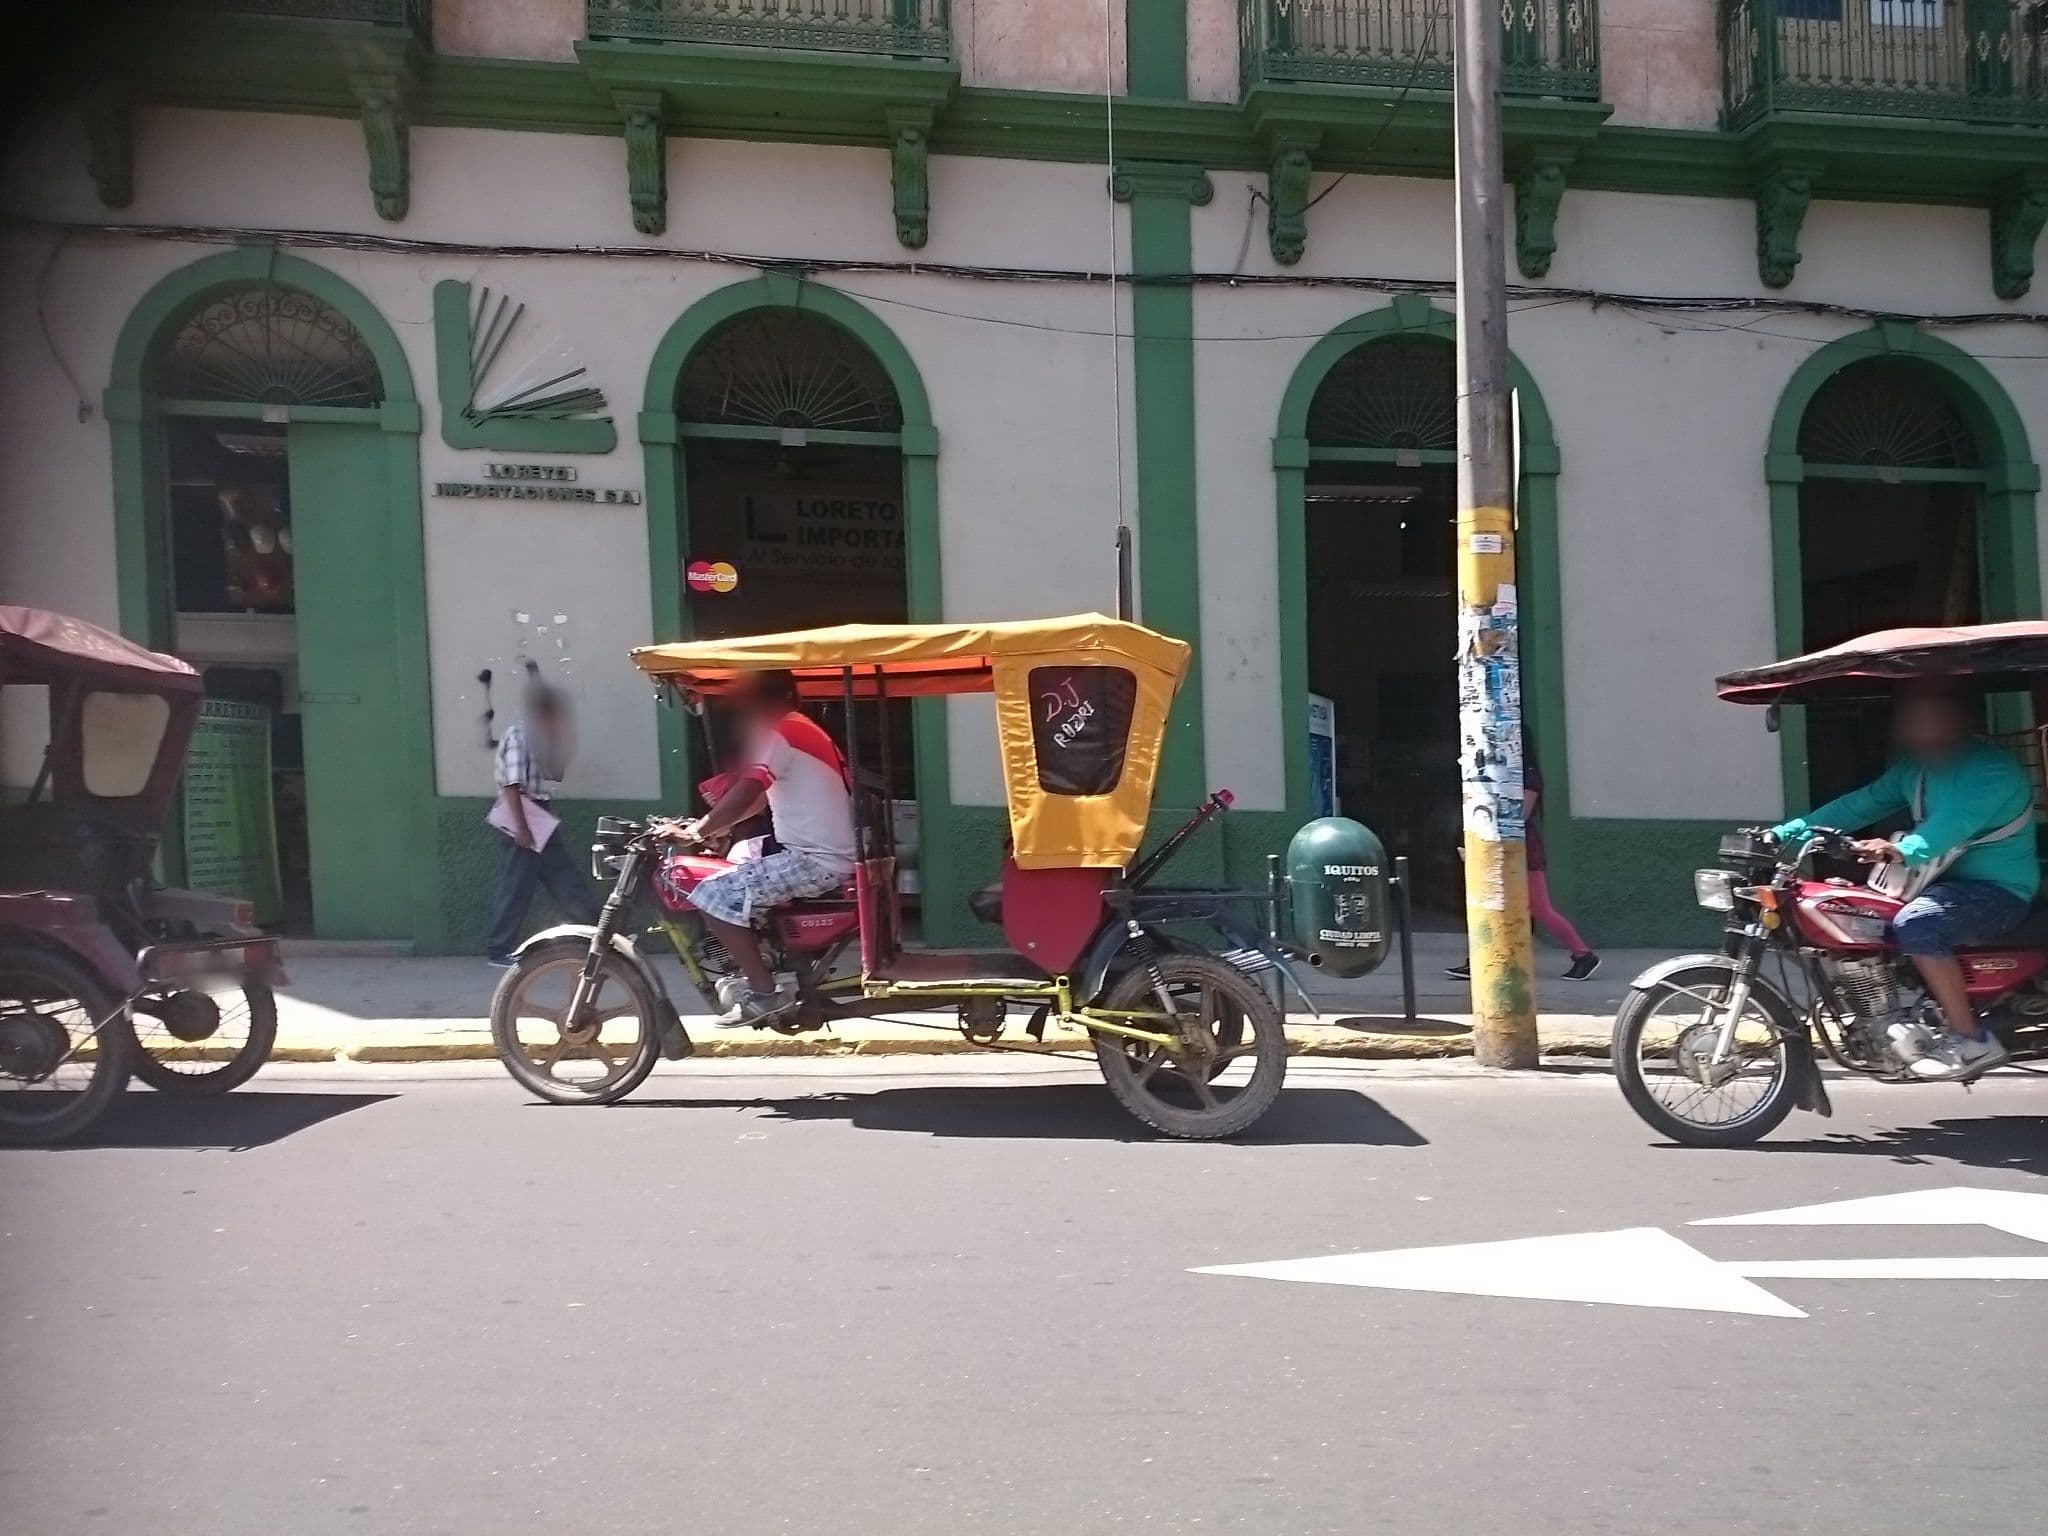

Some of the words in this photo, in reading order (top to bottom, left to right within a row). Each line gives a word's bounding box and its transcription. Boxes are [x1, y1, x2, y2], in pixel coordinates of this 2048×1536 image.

[488, 464, 568, 480] LORETO
[437, 483, 596, 503] IMPORTACIONES
[797, 498, 897, 521] LORETO
[688, 571, 737, 582] MasterCard
[1323, 865, 1379, 876] IQUITOS
